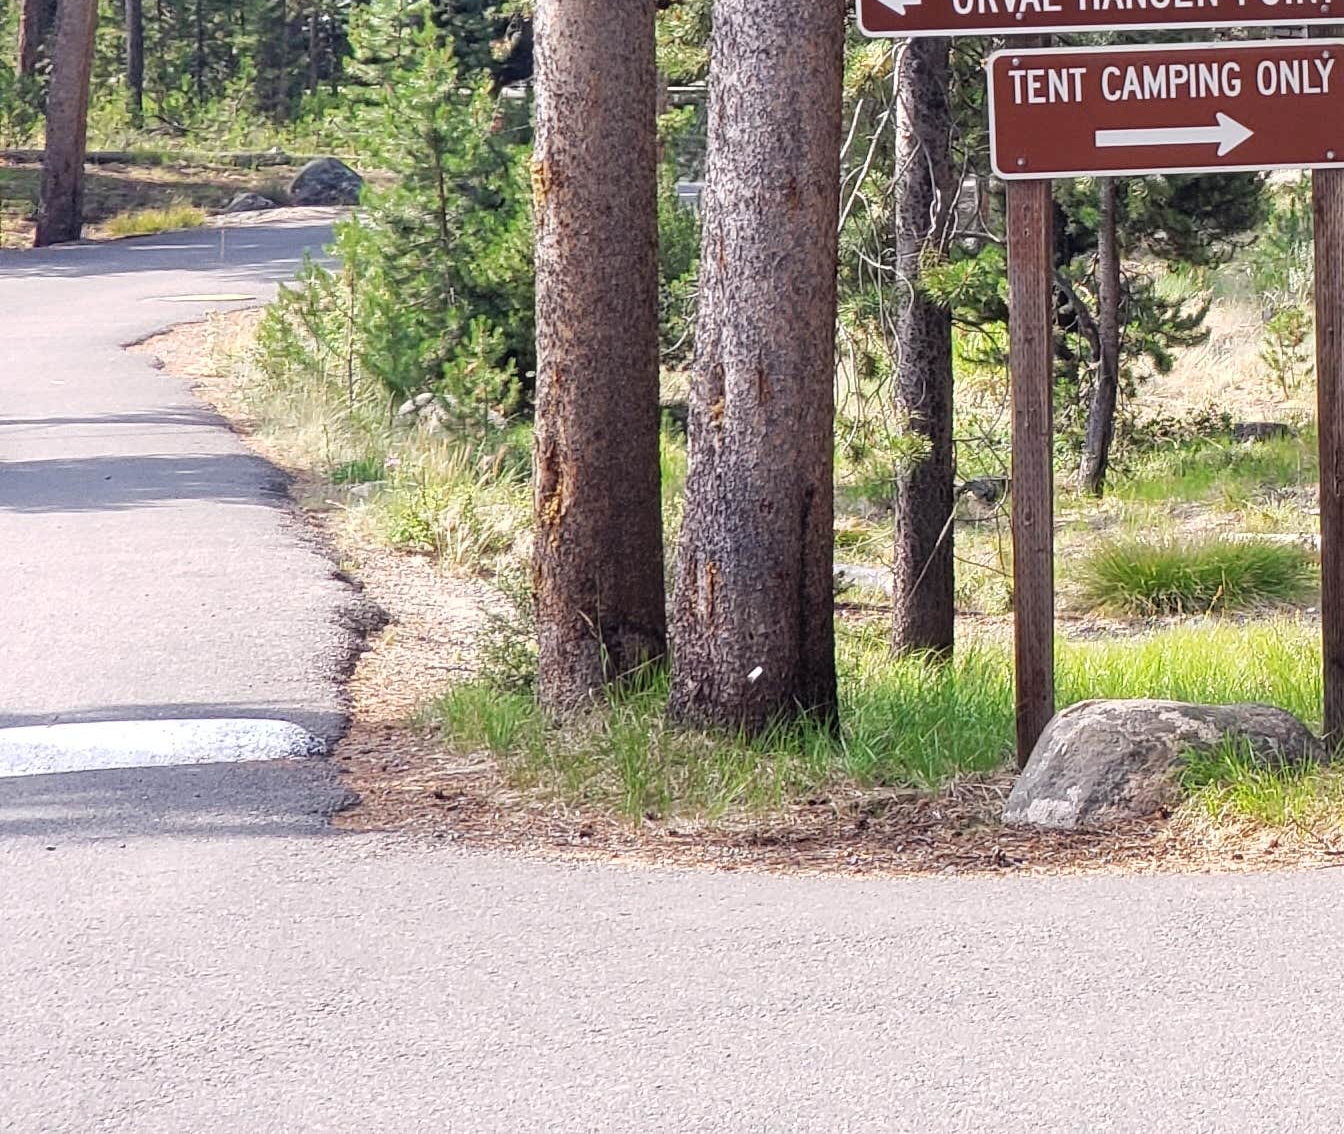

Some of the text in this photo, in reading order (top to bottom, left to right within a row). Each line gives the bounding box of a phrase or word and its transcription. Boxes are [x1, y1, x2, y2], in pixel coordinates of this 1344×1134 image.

[1007, 58, 1336, 104] TENT CAMPING ONLY
